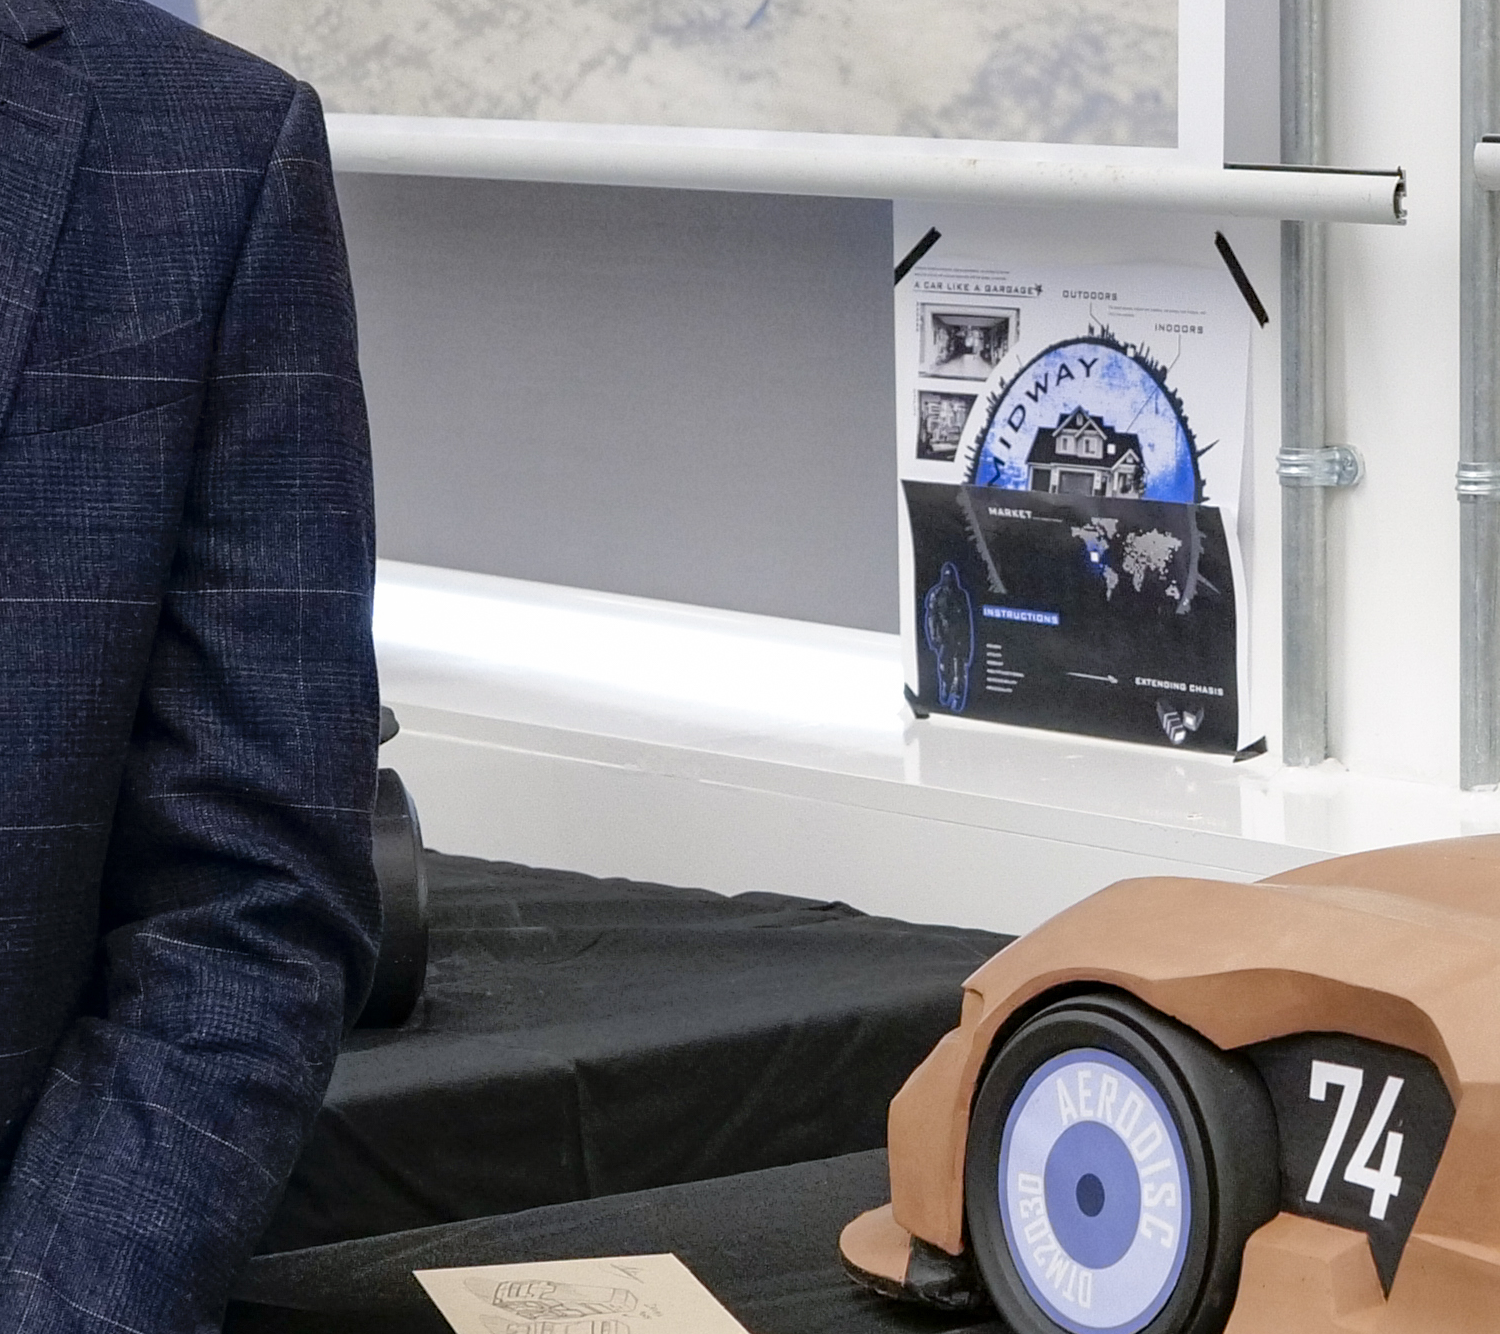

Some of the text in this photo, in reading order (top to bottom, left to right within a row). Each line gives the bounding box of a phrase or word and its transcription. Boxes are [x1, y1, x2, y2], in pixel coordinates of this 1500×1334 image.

[924, 281, 943, 290] CAR
[947, 283, 970, 292] LIKE
[974, 284, 980, 292] A
[1062, 289, 1118, 301] OUTDOORS
[1155, 323, 1204, 334] INDOORS
[988, 506, 1033, 520] MARKET
[983, 607, 1059, 624] INSTRUCTIONS
[1135, 676, 1224, 697] EXTENDING CHASIS
[1305, 1059, 1404, 1221] 74
[1055, 1069, 1176, 1249] AERODISC
